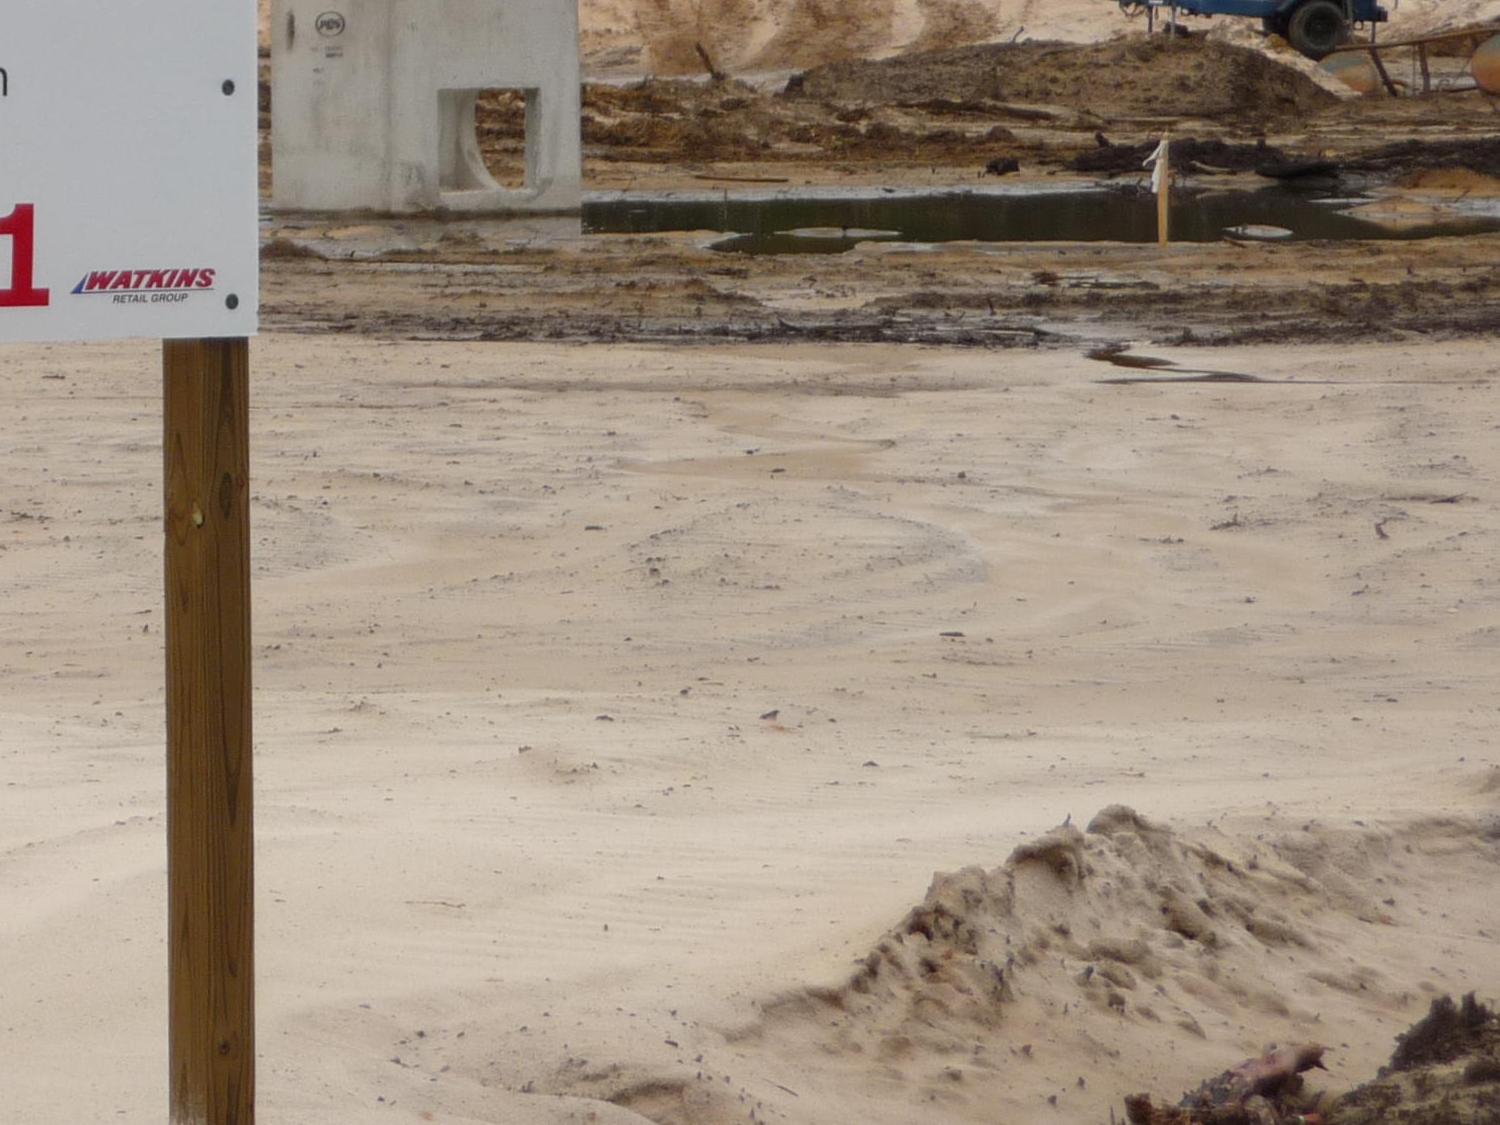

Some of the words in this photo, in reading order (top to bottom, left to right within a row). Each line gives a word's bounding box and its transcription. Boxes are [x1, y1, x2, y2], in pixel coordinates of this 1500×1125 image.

[84, 267, 216, 292] WATKINS
[112, 293, 149, 305] RETAIL
[150, 292, 189, 304] GROUP
